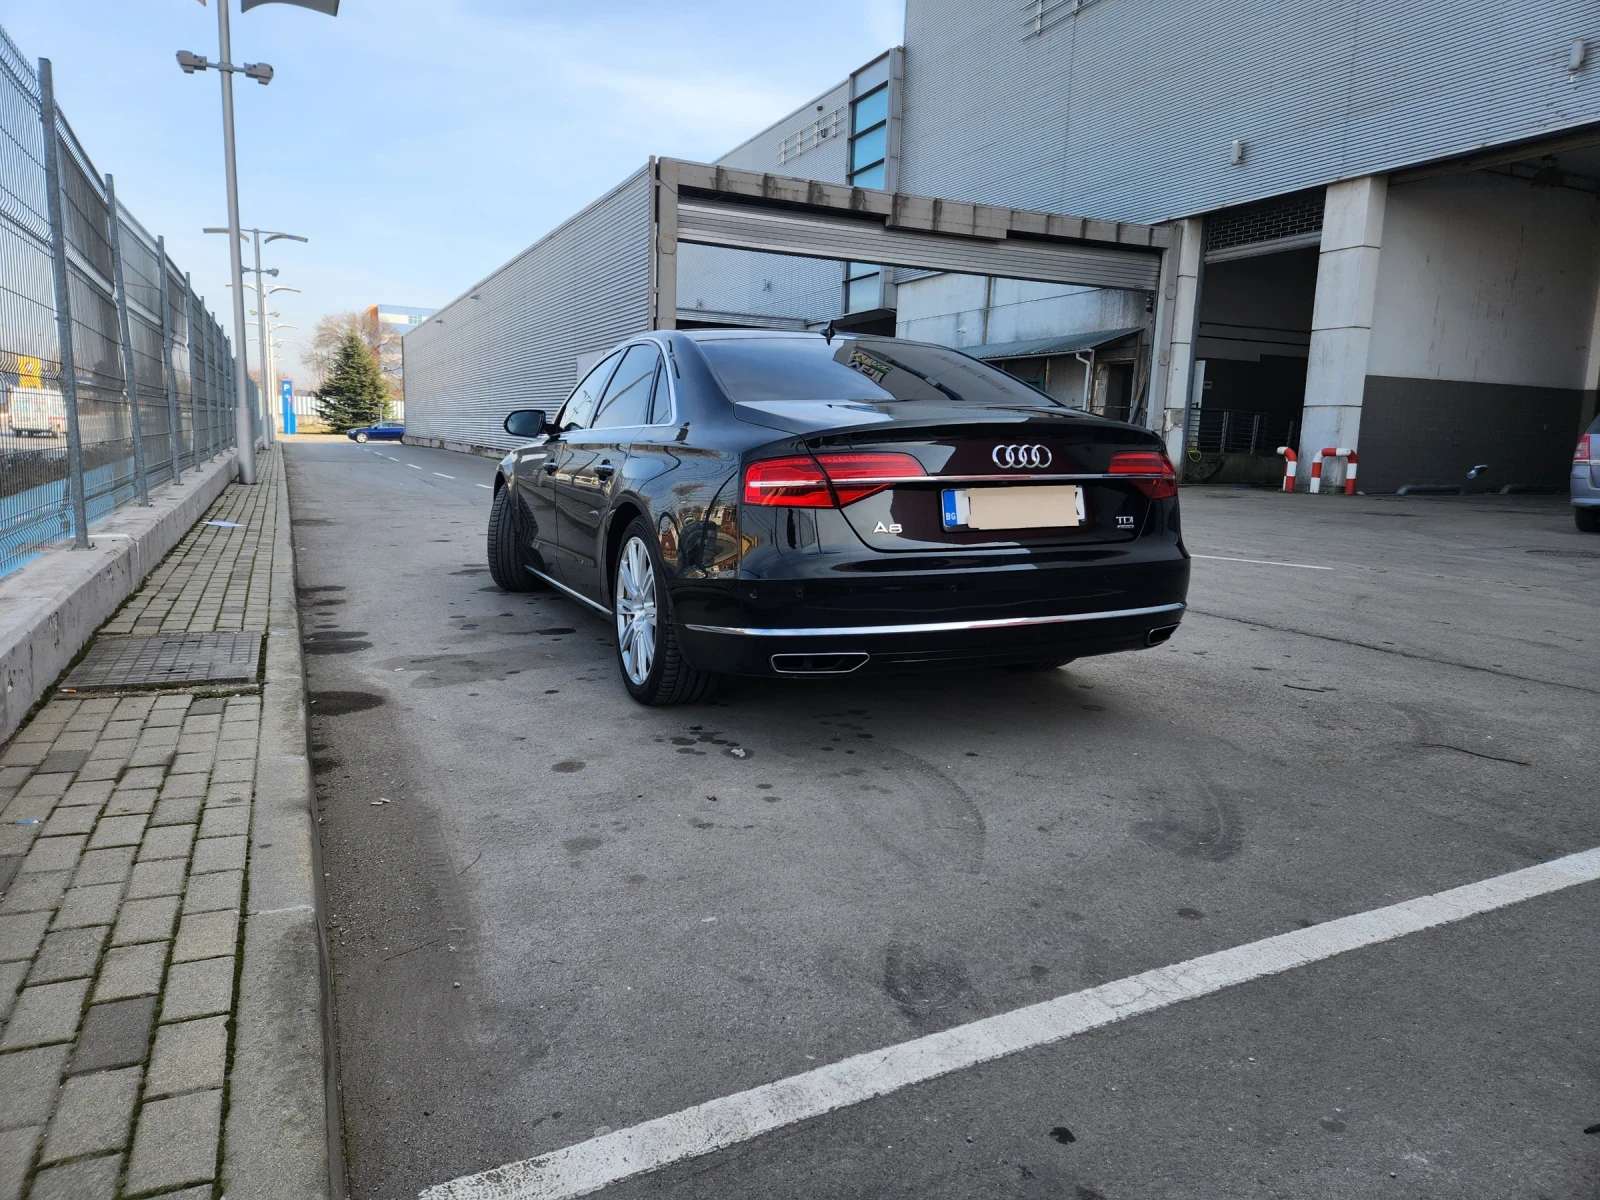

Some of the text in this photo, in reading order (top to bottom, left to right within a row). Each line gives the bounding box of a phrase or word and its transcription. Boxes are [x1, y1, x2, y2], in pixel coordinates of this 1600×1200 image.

[945, 512, 957, 521] BG
[1115, 516, 1134, 524] TDI
[873, 521, 903, 534] A8
